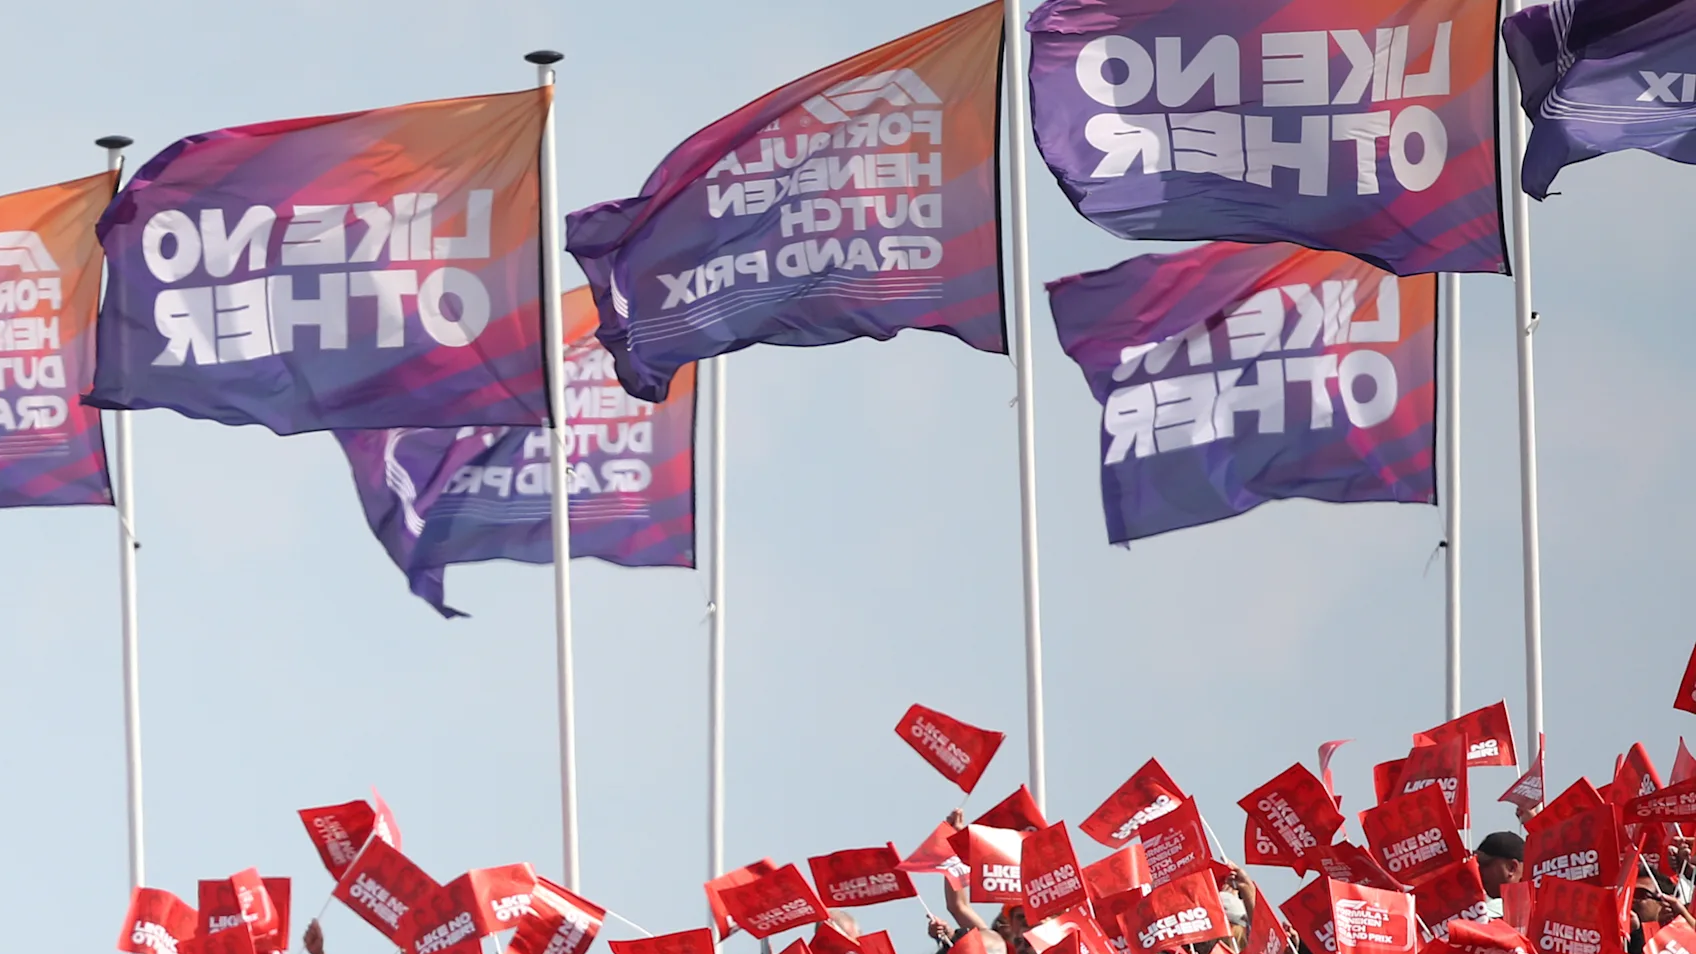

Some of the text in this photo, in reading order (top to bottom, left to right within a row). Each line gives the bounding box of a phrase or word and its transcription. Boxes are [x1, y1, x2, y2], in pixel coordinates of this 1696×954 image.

[911, 724, 966, 774] OTHER!
[916, 716, 970, 763] LIKE NO
[1470, 739, 1497, 751] NO
[1258, 800, 1305, 857] OTHER!
[1267, 793, 1316, 847] LIKE NO
[1383, 828, 1442, 861] LIKE NO
[1389, 839, 1448, 872] OTHER!
[983, 864, 1020, 878] LIKE
[1533, 850, 1598, 876] LIKE NO
[830, 872, 895, 892] LIKE NO
[1026, 865, 1074, 896] LIKE NO
[1030, 877, 1081, 909] OTHER!
[416, 912, 472, 954] LIKE NO
[1138, 907, 1207, 942] LIKE NO
[1142, 921, 1212, 948] OTHER!
[1544, 921, 1600, 943] LIKE NO
